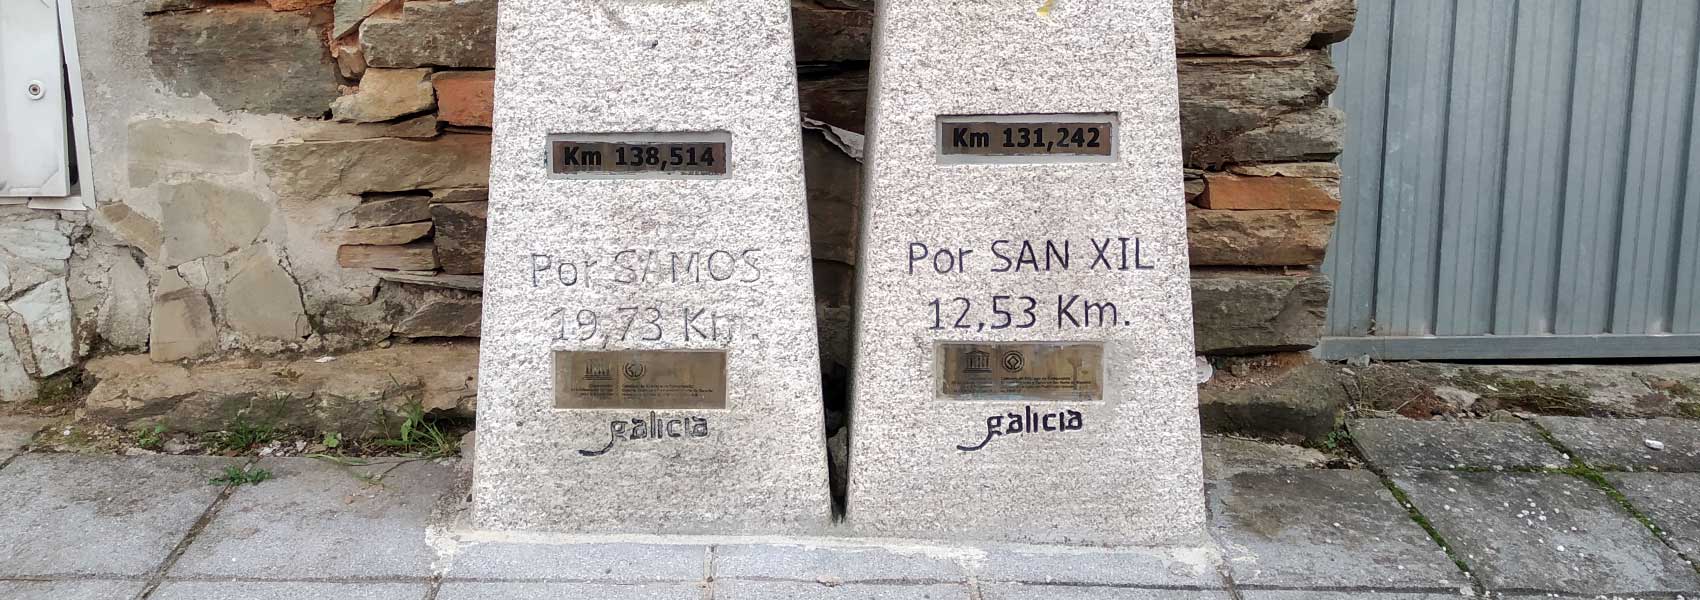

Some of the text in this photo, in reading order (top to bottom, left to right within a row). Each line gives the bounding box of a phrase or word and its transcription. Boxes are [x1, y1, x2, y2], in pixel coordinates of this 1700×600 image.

[952, 127, 1100, 152] Km 131,242
[563, 147, 714, 171] Km 138,514
[531, 253, 597, 288] Por
[908, 237, 1154, 275] Por SAN XIL
[544, 306, 663, 348] 19,73
[928, 294, 1131, 332] 12,53 Km.
[578, 411, 708, 456] galicia
[956, 406, 1083, 451] galicia
